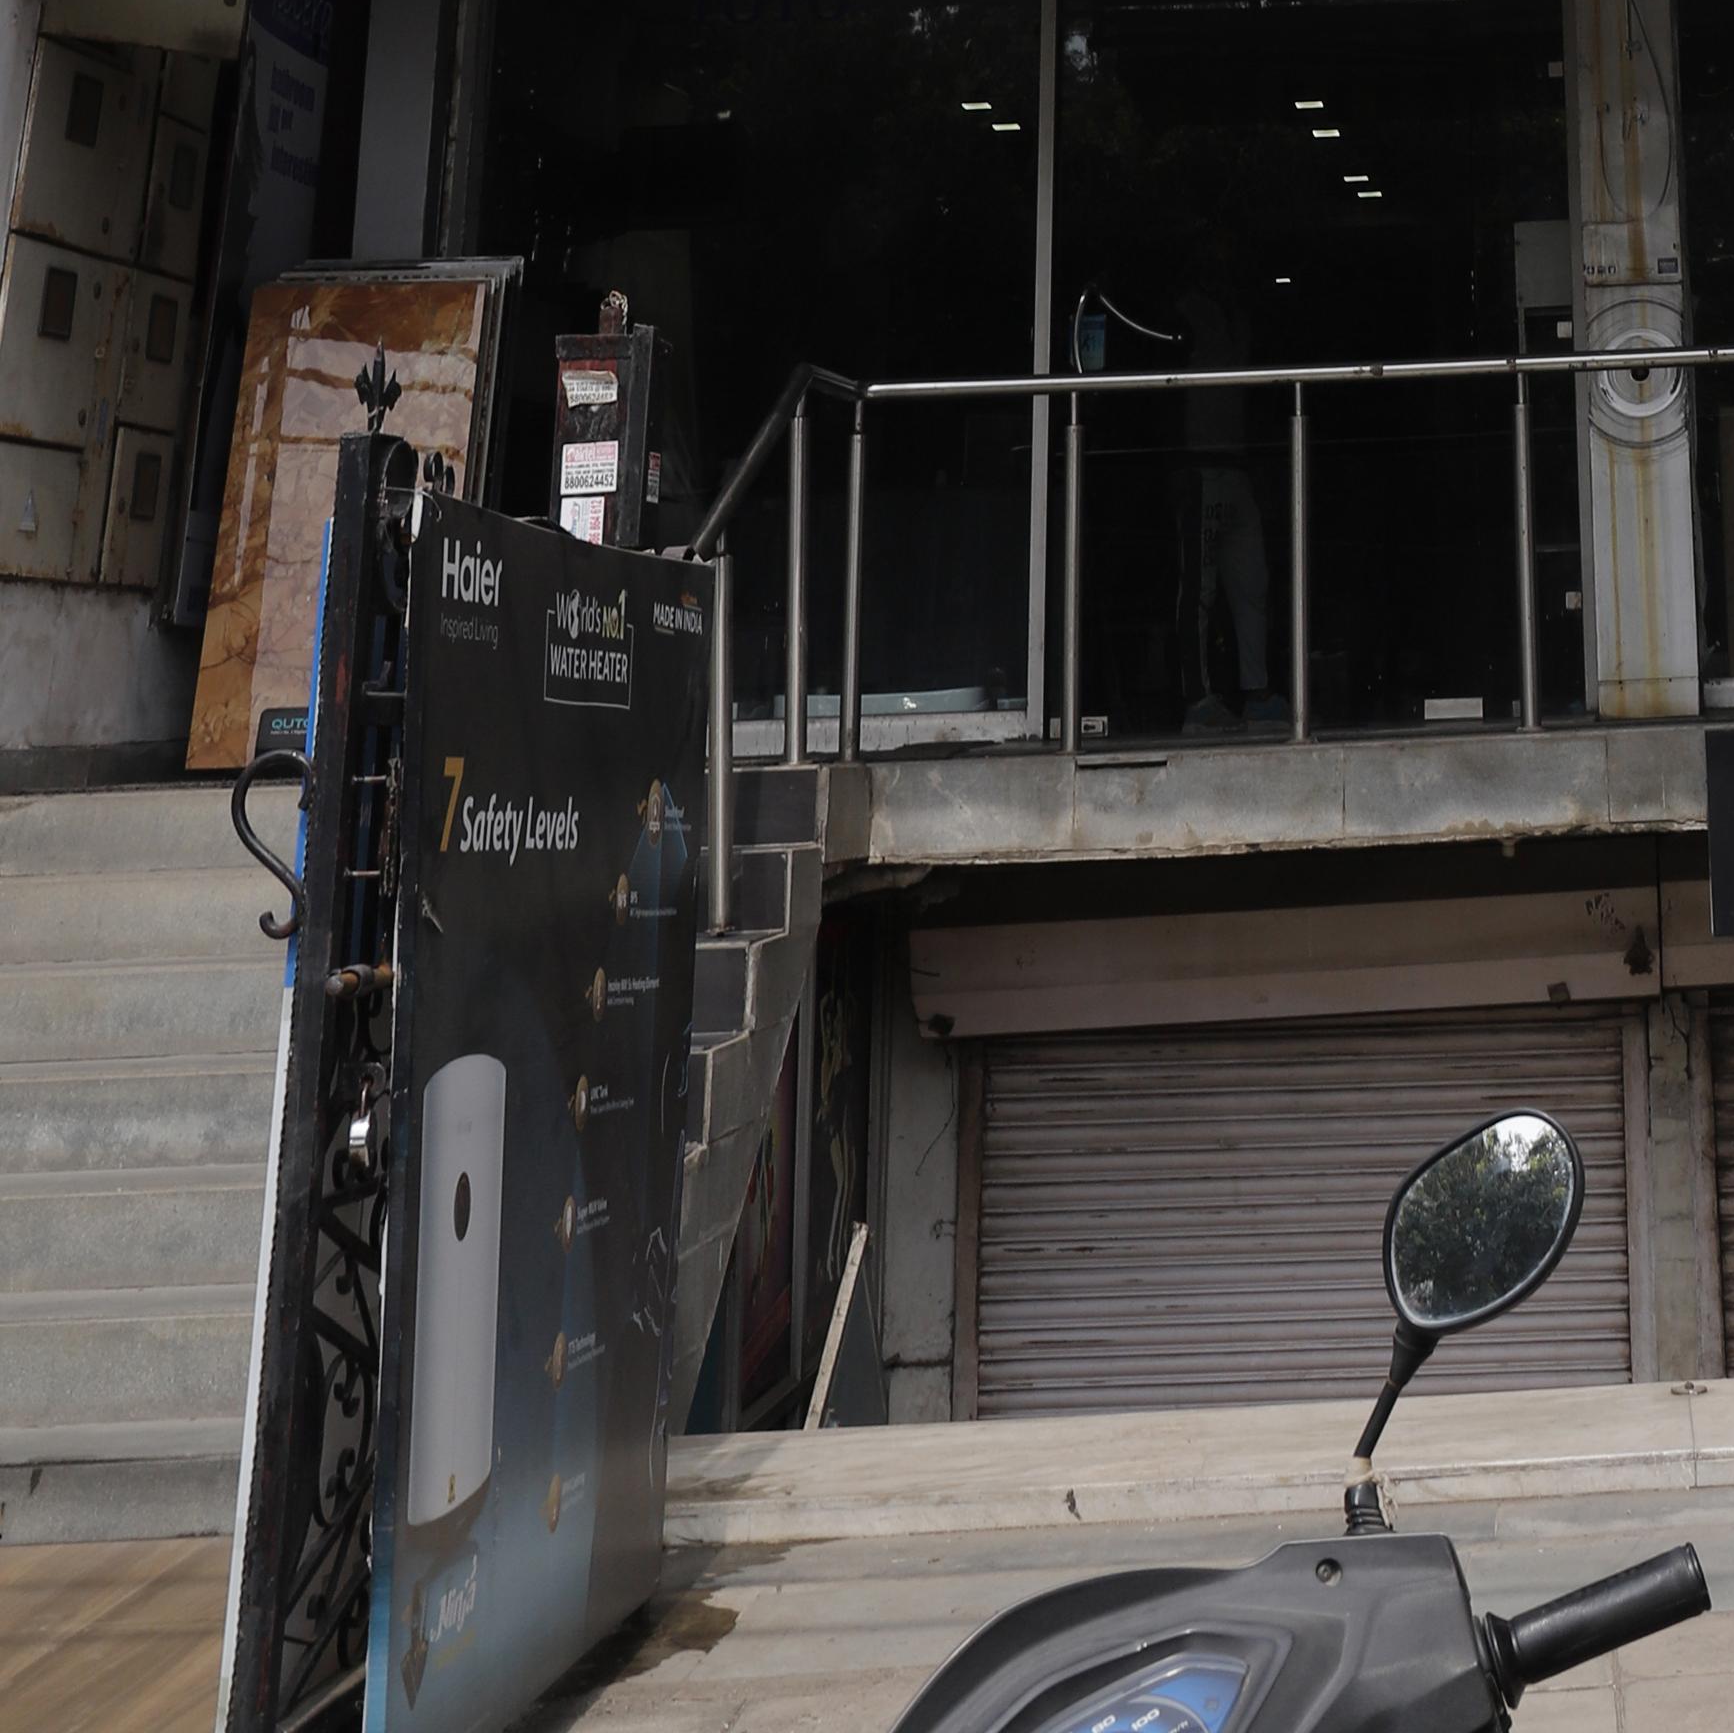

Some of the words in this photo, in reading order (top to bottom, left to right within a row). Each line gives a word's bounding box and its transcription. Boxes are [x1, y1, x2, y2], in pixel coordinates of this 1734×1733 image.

[565, 474, 614, 489] 8800624452
[442, 537, 502, 607] Haier
[653, 601, 675, 629] MADE
[675, 607, 683, 630] IN
[683, 610, 703, 636] INDIA
[551, 643, 587, 679] WATER
[588, 649, 628, 684] HEATER
[439, 757, 464, 852] 7
[460, 795, 524, 865] Safety
[526, 795, 579, 850] Levels
